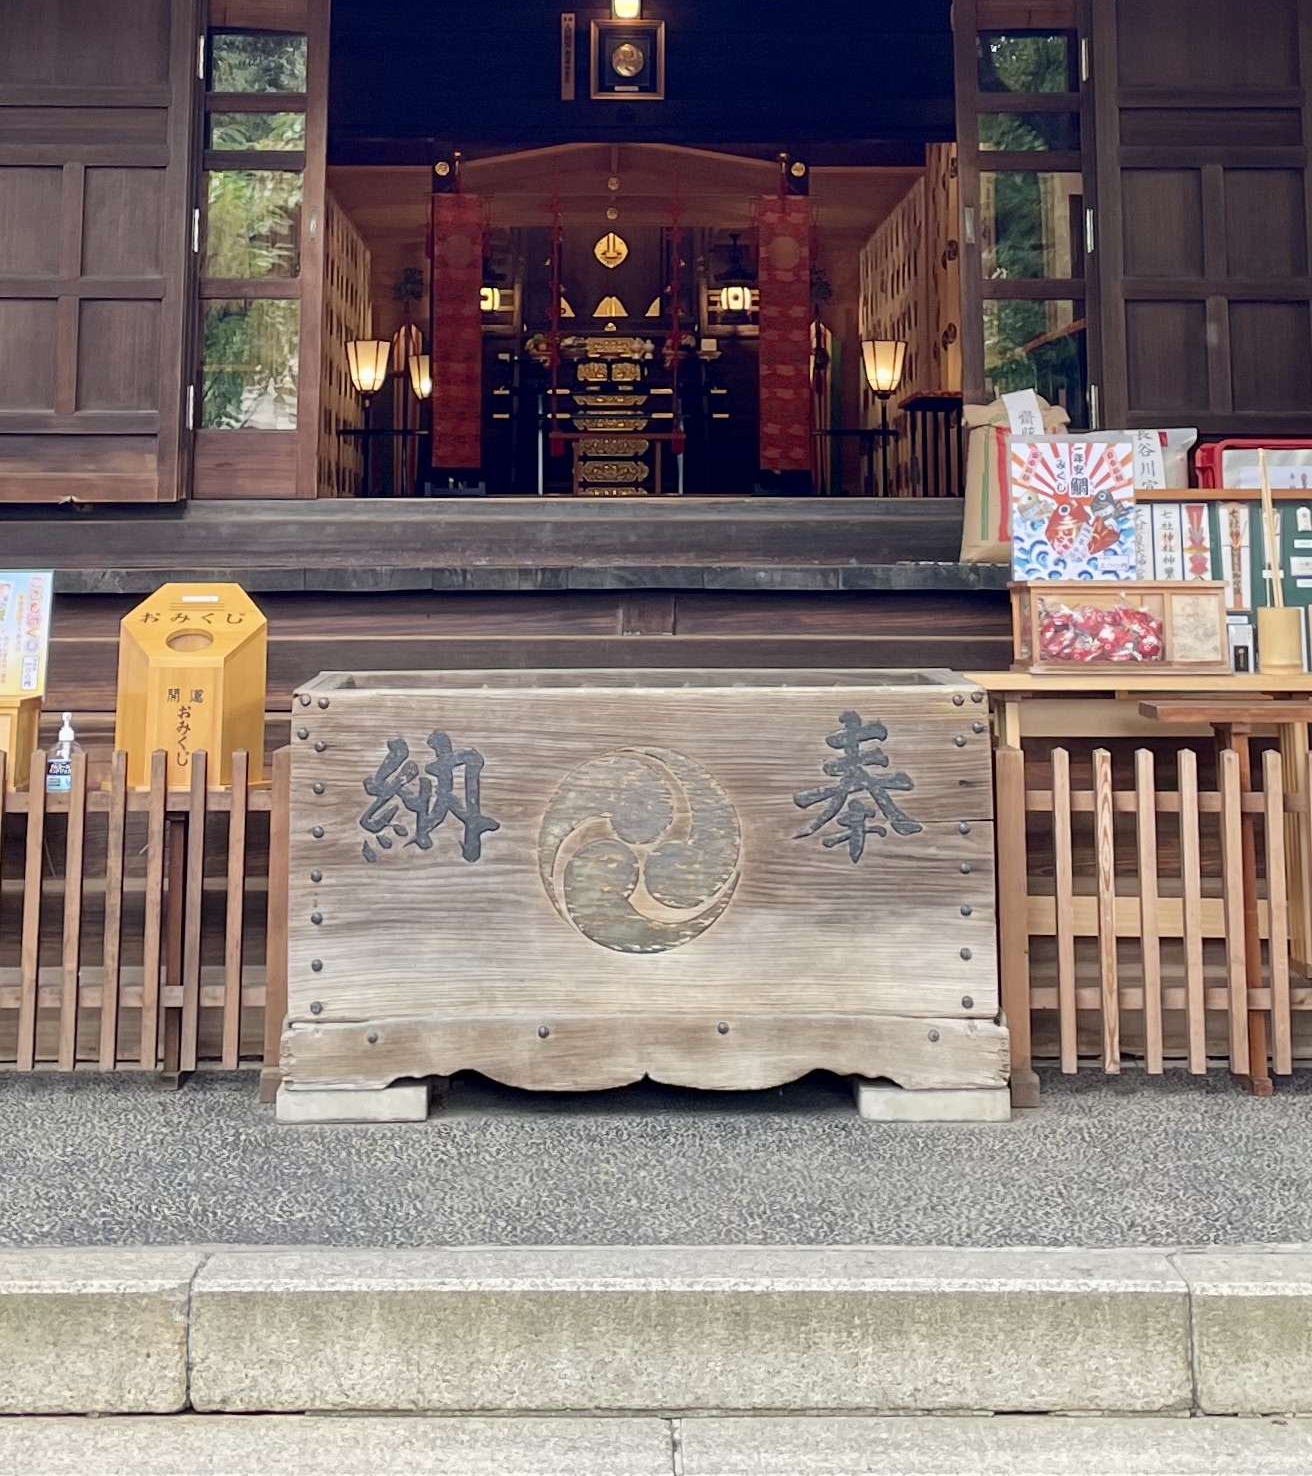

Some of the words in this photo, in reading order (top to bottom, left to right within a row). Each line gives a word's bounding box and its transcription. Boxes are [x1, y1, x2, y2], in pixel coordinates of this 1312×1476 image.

[140, 612, 246, 624] おみくじ
[166, 688, 204, 703] 開運
[176, 705, 191, 767] おみくじ
[358, 730, 501, 864] 納
[790, 710, 924, 864] 奉
